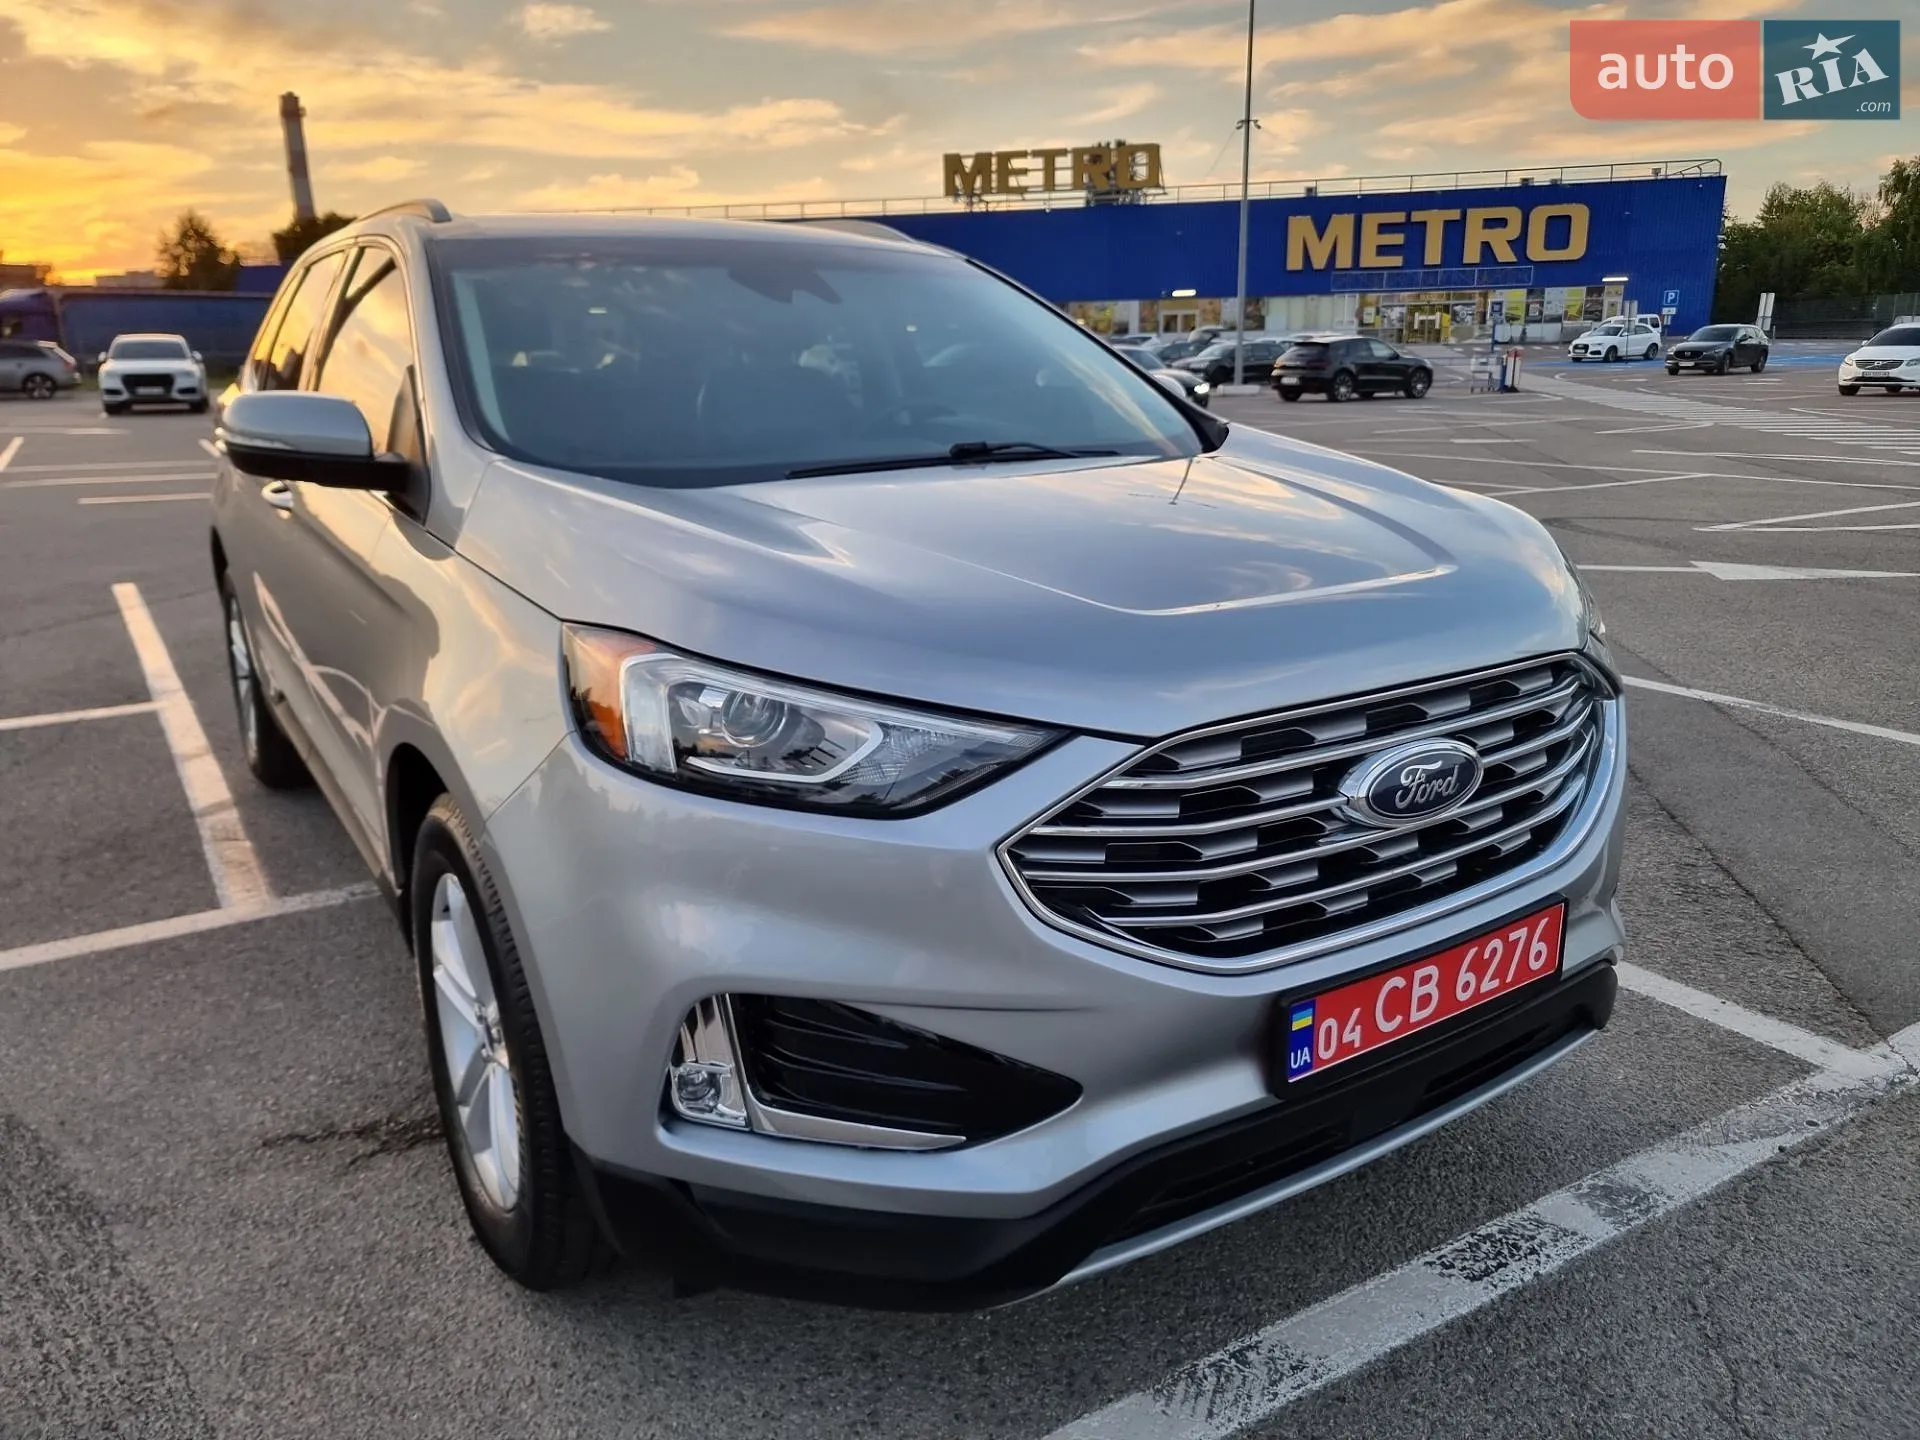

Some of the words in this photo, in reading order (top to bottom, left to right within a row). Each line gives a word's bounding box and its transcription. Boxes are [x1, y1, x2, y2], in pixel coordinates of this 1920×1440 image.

[943, 143, 1160, 197] METRO
[1286, 203, 1590, 270] METRO
[1394, 760, 1460, 810] Ford
[1318, 1007, 1362, 1060] 04
[1375, 965, 1440, 1033] CB
[1456, 918, 1549, 1002] 6276
[1290, 1046, 1312, 1069] UA
